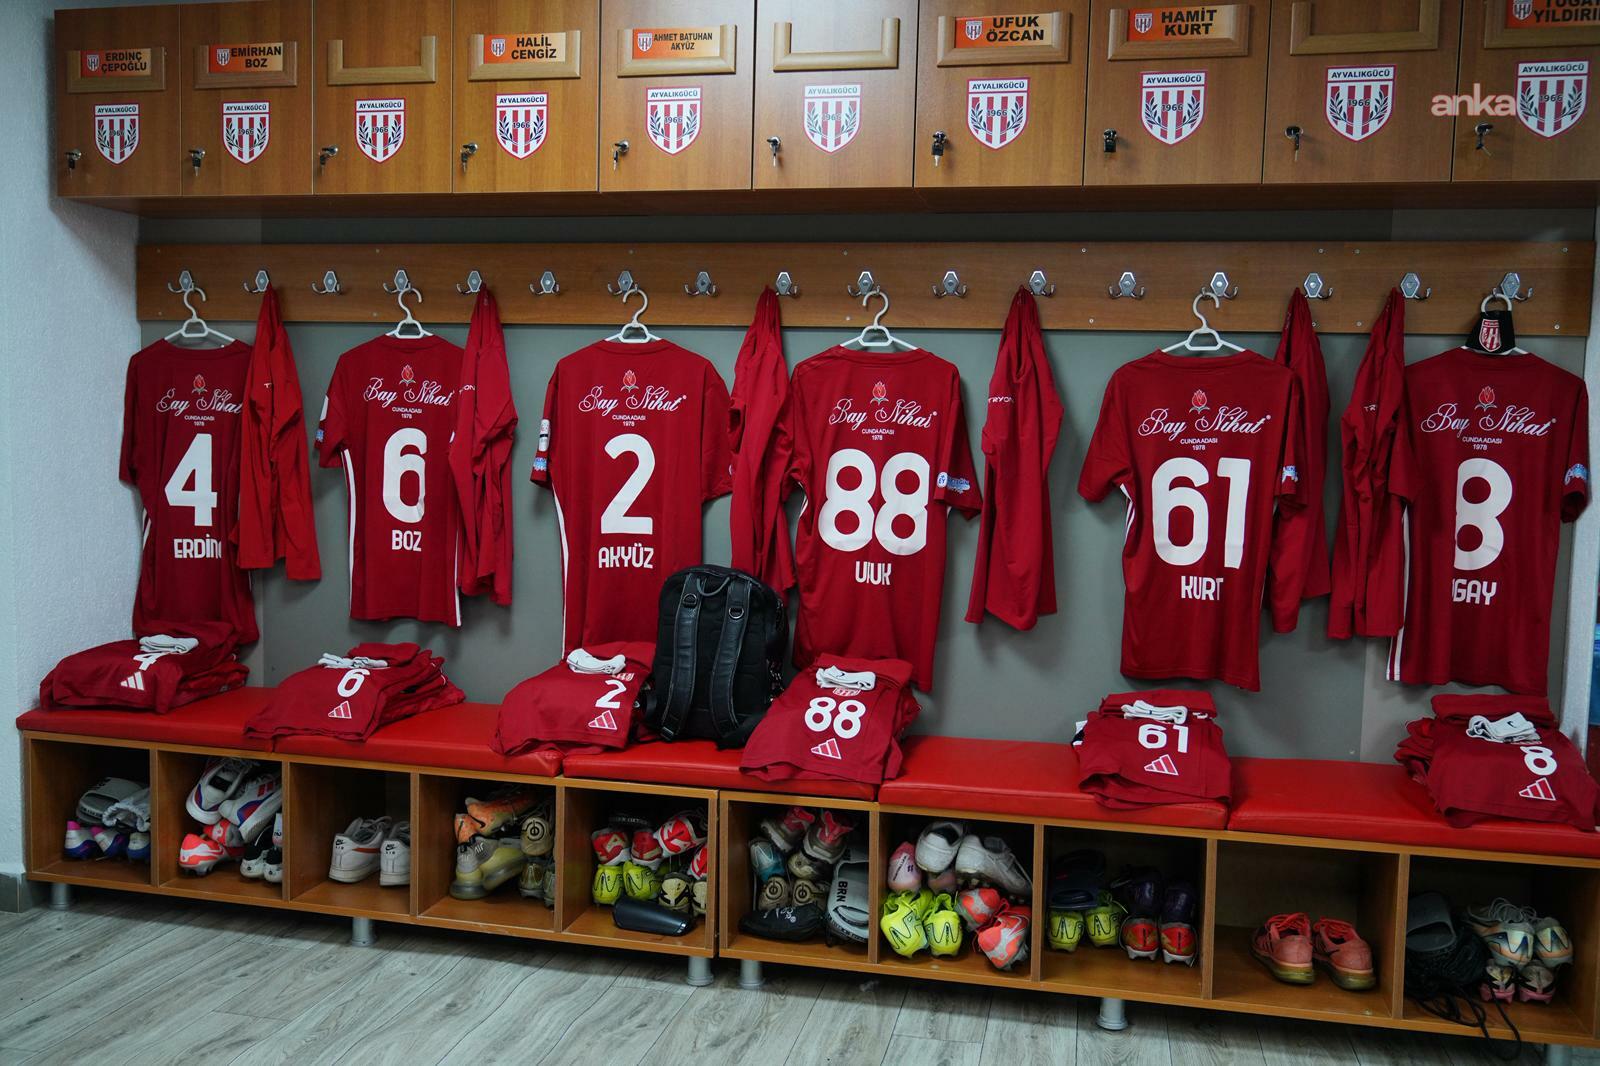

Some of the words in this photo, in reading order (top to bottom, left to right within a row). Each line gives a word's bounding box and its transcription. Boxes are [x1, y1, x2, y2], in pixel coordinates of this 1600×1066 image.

[992, 15, 1040, 29] UFUK
[1160, 7, 1218, 24] HAMİT
[1534, 8, 1600, 23] YILDIRI
[653, 33, 678, 42] AHMET
[679, 32, 713, 41] BATUHAN
[985, 28, 1045, 42] ÖZCAN
[1163, 23, 1213, 37] KURT
[515, 34, 552, 48] HALİL
[670, 41, 695, 51] AKYÜZ
[105, 51, 142, 62] ERDİNÇ
[231, 45, 281, 57] EMİRHAN
[511, 45, 557, 60] CENGİZ
[101, 61, 147, 73] ÇEPOĞLU
[245, 58, 268, 68] BOZ
[1522, 63, 1585, 73] AYVALIKGÜCÜ
[1146, 75, 1202, 85] AYVALIKGÜCÜ
[1331, 70, 1390, 79] AYVALIKGÜCÜ
[807, 87, 858, 96] AYVALIKGÜCÜ
[972, 81, 1025, 91] AYVALIKGÜCÜ
[499, 96, 545, 105] AYVALIKGÜCÜ
[650, 89, 699, 99] AYVALIKGÜCÜ
[1539, 94, 1563, 102] 1966
[225, 103, 267, 112] AYVALIKGÜCÜ
[358, 102, 402, 110] AYVALIKGÜCÜ
[1161, 103, 1183, 112] 1966
[1347, 98, 1371, 107] 1966
[822, 113, 842, 122] 1966
[986, 109, 1008, 117] 1966
[512, 121, 531, 130] 1966
[664, 116, 683, 125] 1966
[363, 376, 398, 409] Bay
[625, 385, 683, 412] Nihat
[828, 398, 868, 431] Bay
[1420, 402, 1470, 438] Bay
[1478, 404, 1553, 437] Nihat
[1138, 408, 1187, 441] Bay
[1194, 405, 1267, 434] Nihat
[1472, 443, 1488, 451] 1978
[164, 433, 218, 527] 4
[382, 427, 428, 524] 6
[600, 433, 656, 535] 2
[818, 448, 930, 556] 88
[1151, 457, 1251, 569] 61
[1453, 457, 1513, 571] 8
[391, 530, 422, 552] BOZ
[598, 543, 654, 569] AKYÜZ
[855, 560, 892, 586] UUK
[1181, 575, 1224, 601] KURT
[1451, 578, 1498, 605] GAY
[133, 652, 169, 671] 4
[337, 668, 371, 698] 6
[595, 679, 627, 709] 2
[804, 696, 867, 739] 88
[1138, 723, 1189, 754] 61
[1519, 746, 1558, 776] 8
[836, 880, 848, 902] BRN
